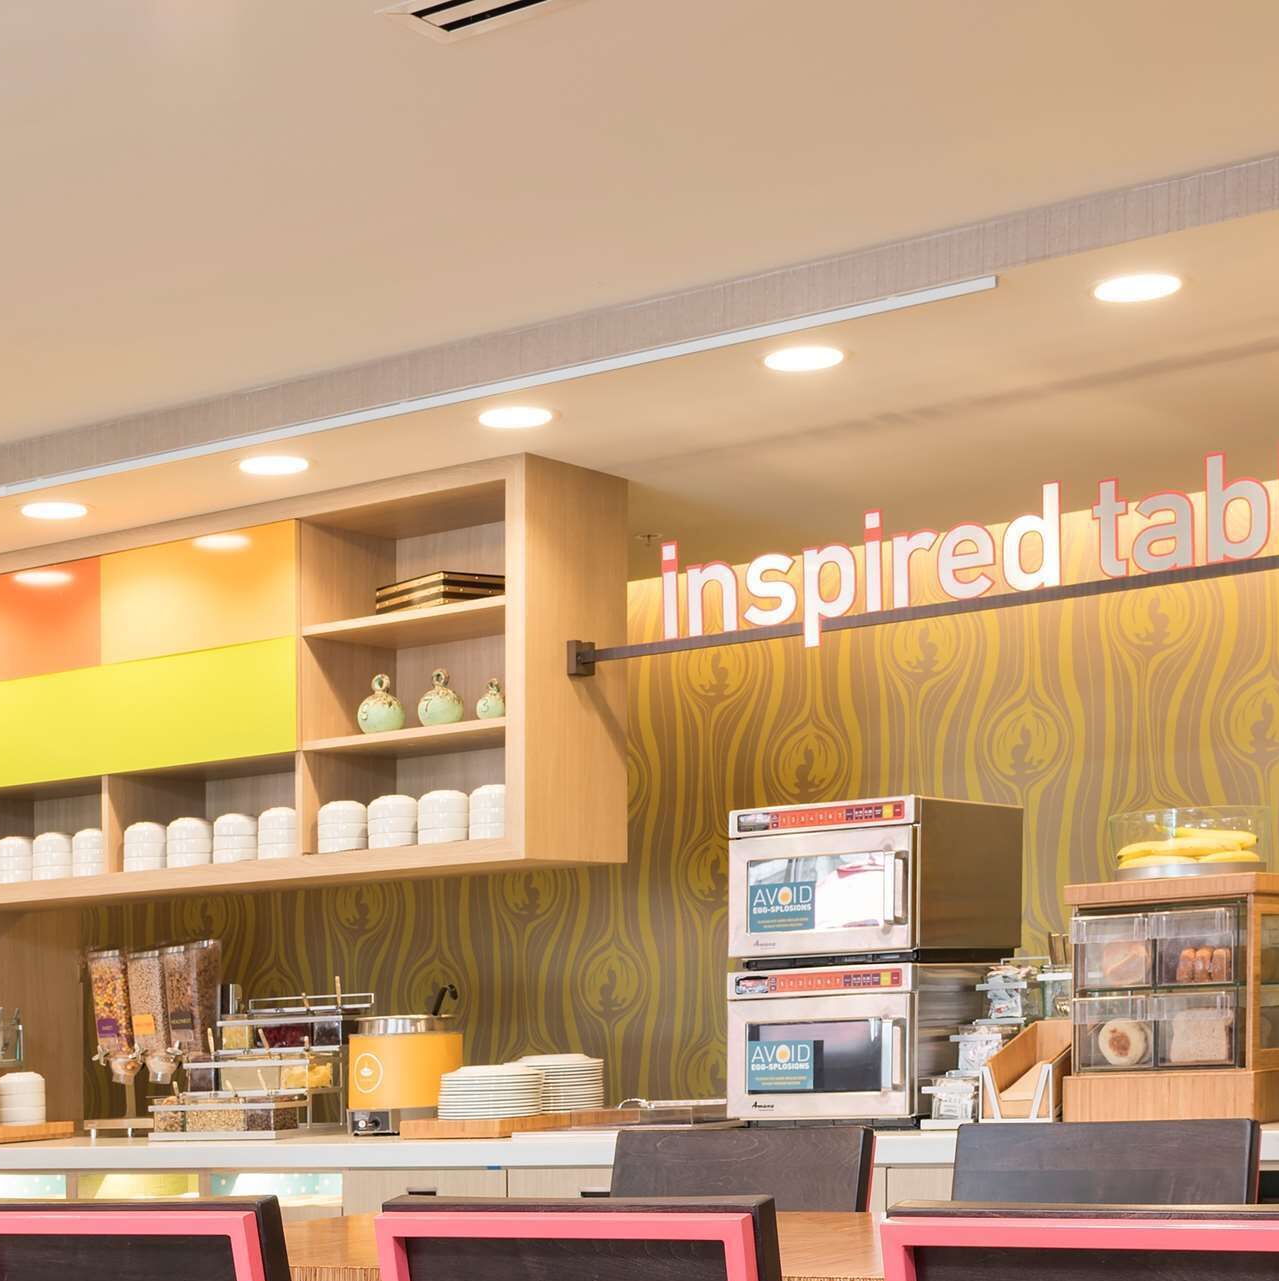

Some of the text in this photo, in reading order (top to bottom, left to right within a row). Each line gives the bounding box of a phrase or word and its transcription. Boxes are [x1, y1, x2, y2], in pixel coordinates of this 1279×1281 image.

[659, 480, 1062, 649] inspired
[753, 886, 813, 906] AVOID
[751, 1044, 810, 1063] AVOID
